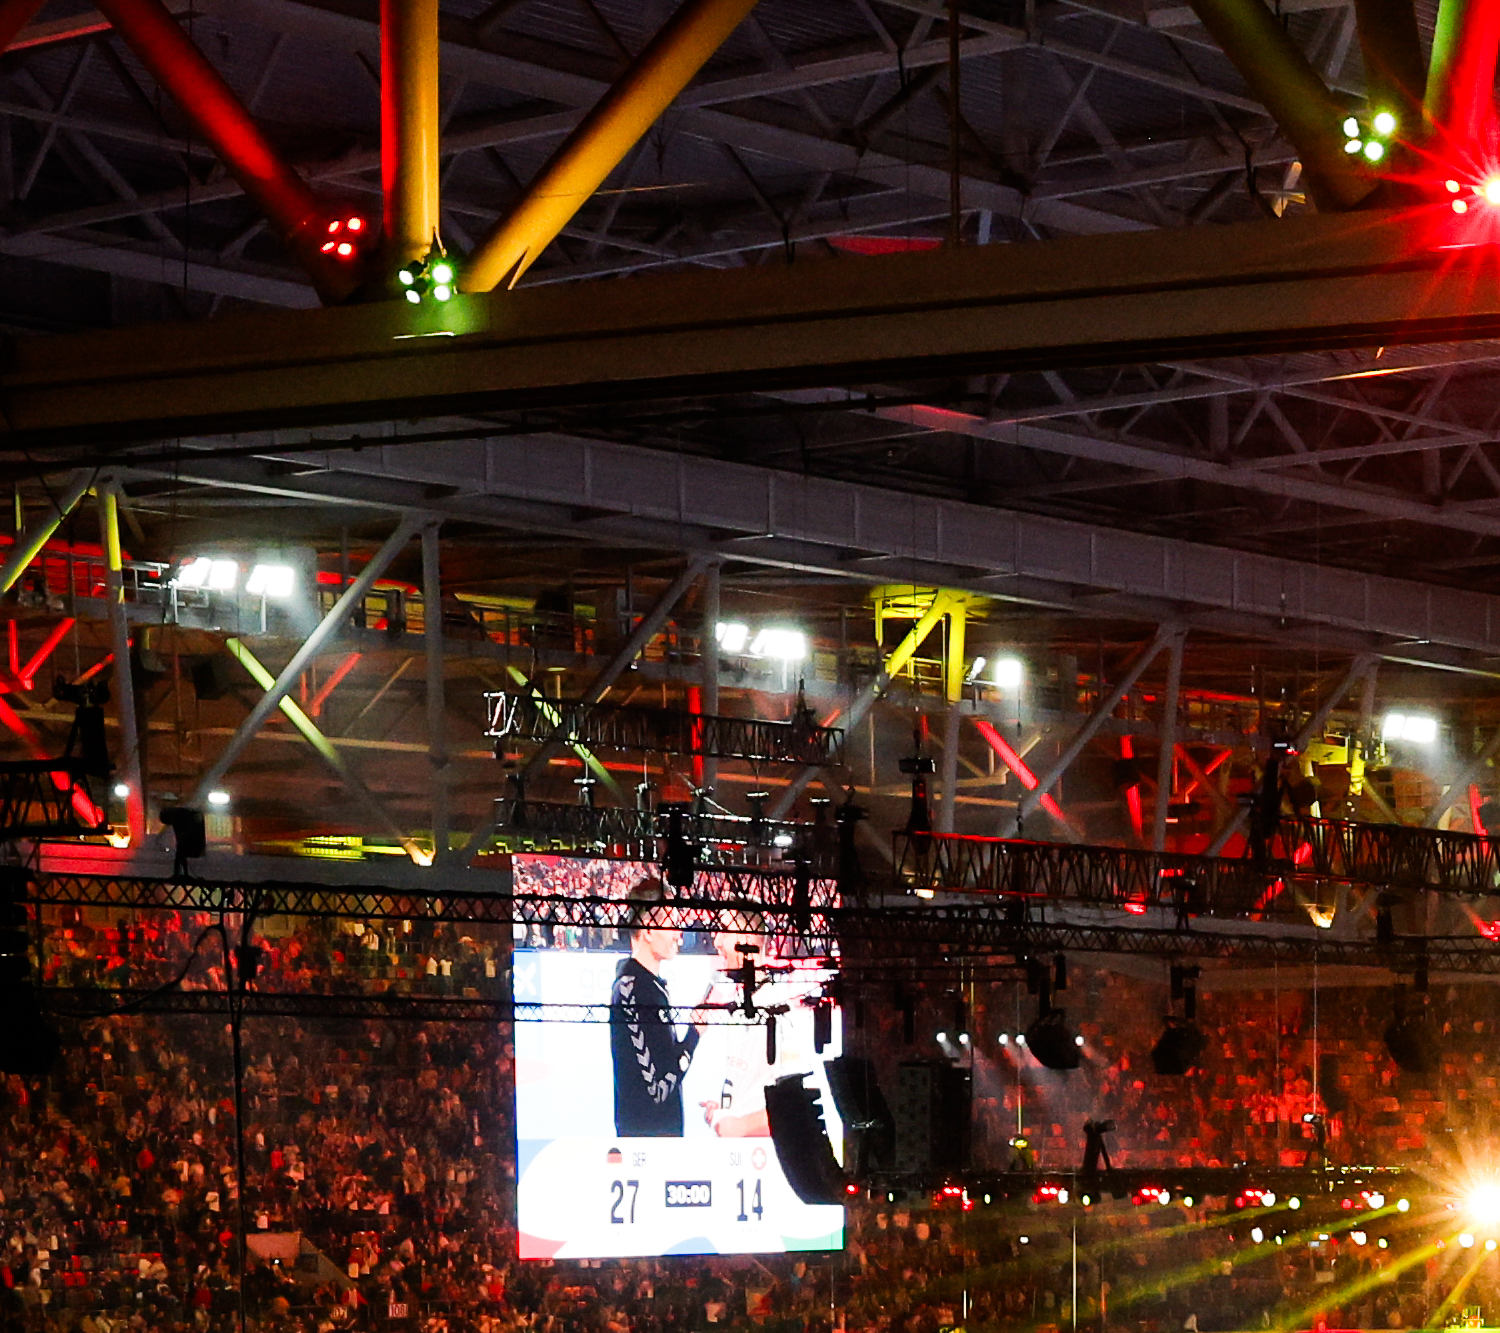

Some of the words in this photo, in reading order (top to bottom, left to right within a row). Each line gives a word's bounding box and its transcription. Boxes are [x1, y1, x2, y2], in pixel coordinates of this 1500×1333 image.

[632, 1151, 647, 1167] GER
[729, 1151, 742, 1167] SUI
[610, 1178, 640, 1225] 27
[666, 1184, 711, 1205] 30:00
[735, 1177, 765, 1222] 14
